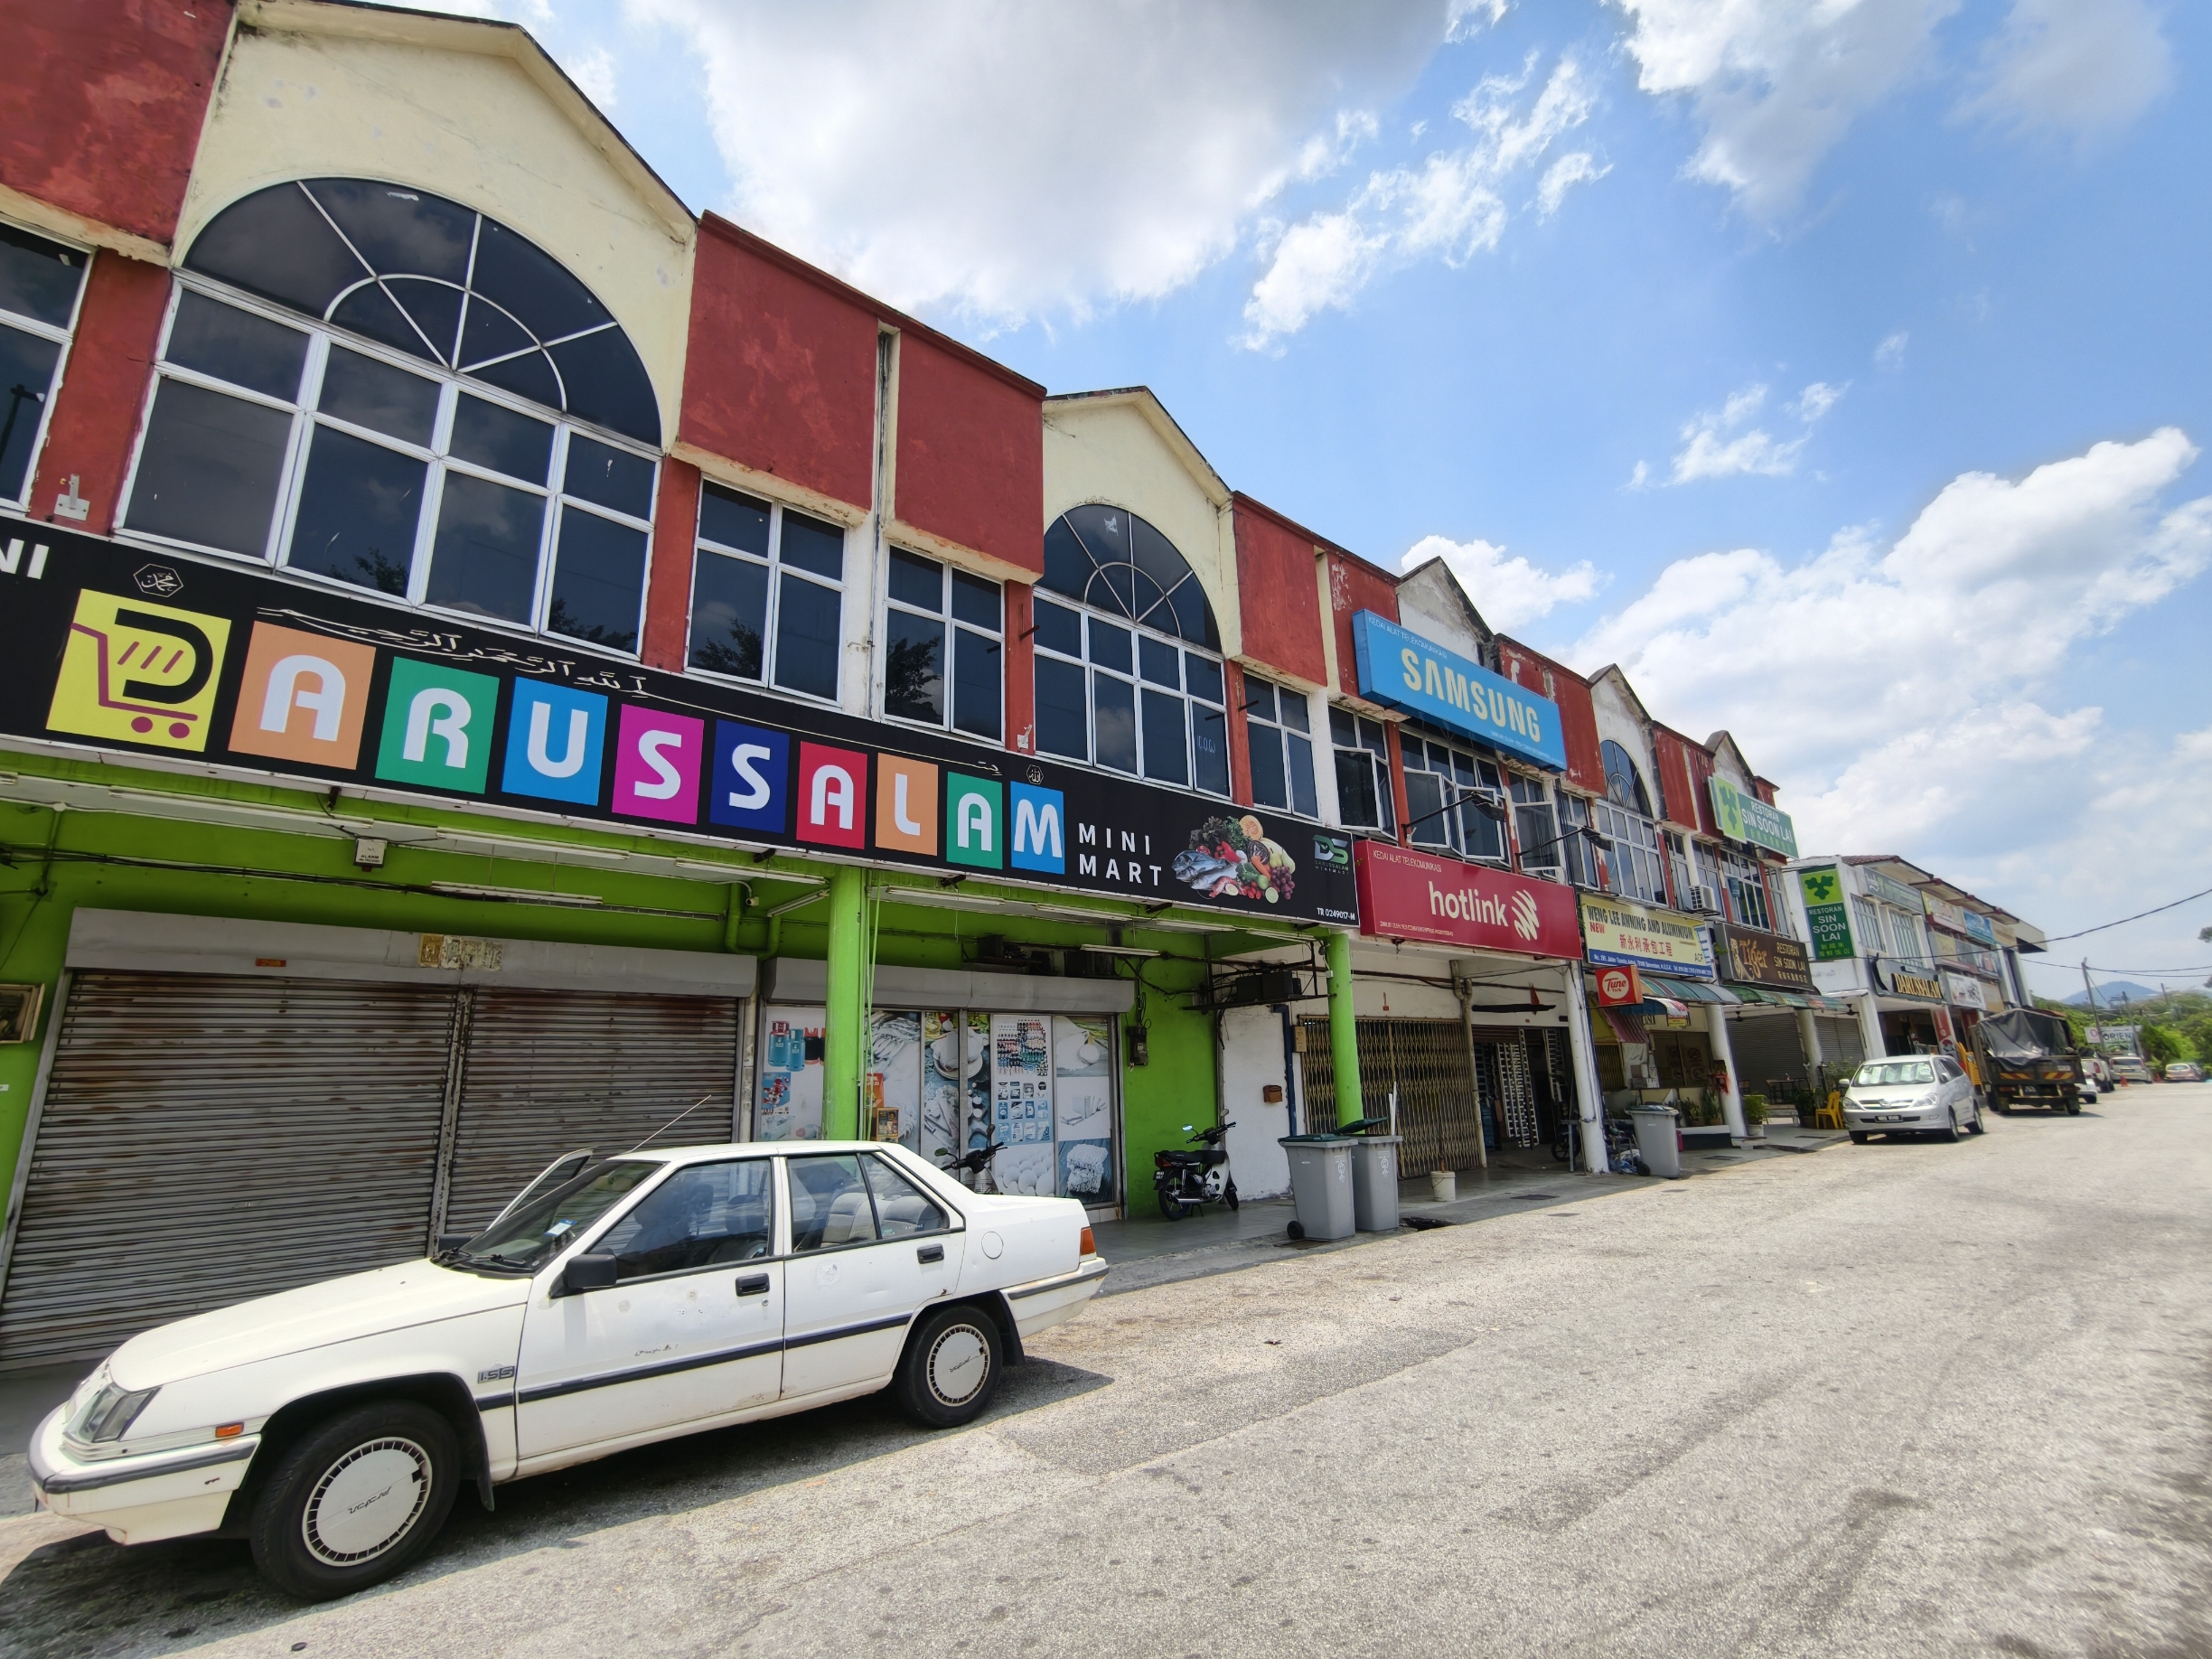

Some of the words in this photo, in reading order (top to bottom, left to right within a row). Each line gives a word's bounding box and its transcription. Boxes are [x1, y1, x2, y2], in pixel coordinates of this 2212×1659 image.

[1368, 616, 1386, 630] KEDAI
[1387, 626, 1400, 637] ALAT
[1401, 648, 1541, 743] SAMSUNG
[1750, 801, 1780, 823] RESTORAN
[1741, 809, 1757, 828] SIN
[1757, 816, 1780, 839] SOON
[1780, 826, 1794, 844] LAI
[1079, 822, 1150, 854] MINI
[1373, 849, 1388, 860] KEDAI
[1390, 853, 1401, 863] ALAT
[1080, 853, 1162, 886] MART
[1317, 907, 1325, 916] TR
[1428, 880, 1508, 927] hotlink
[1808, 905, 1842, 914] RESTORAN
[1587, 904, 1608, 923] WENG
[1608, 909, 1620, 926] LEE
[1621, 912, 1646, 932] AWNING
[1647, 918, 1661, 934] AND
[1589, 922, 1605, 933] NEW
[1818, 914, 1837, 923] SIN
[1813, 923, 1846, 933] SOON
[1822, 932, 1841, 942] LAI
[1776, 942, 1800, 957] RESTORAN
[1739, 939, 1768, 979] Tiger
[1773, 956, 1783, 968] SIN
[1783, 958, 1797, 970] SOON
[1797, 961, 1806, 971] LAI
[1604, 977, 1626, 991] Tune
[1894, 972, 1942, 998] DARUSSALAM
